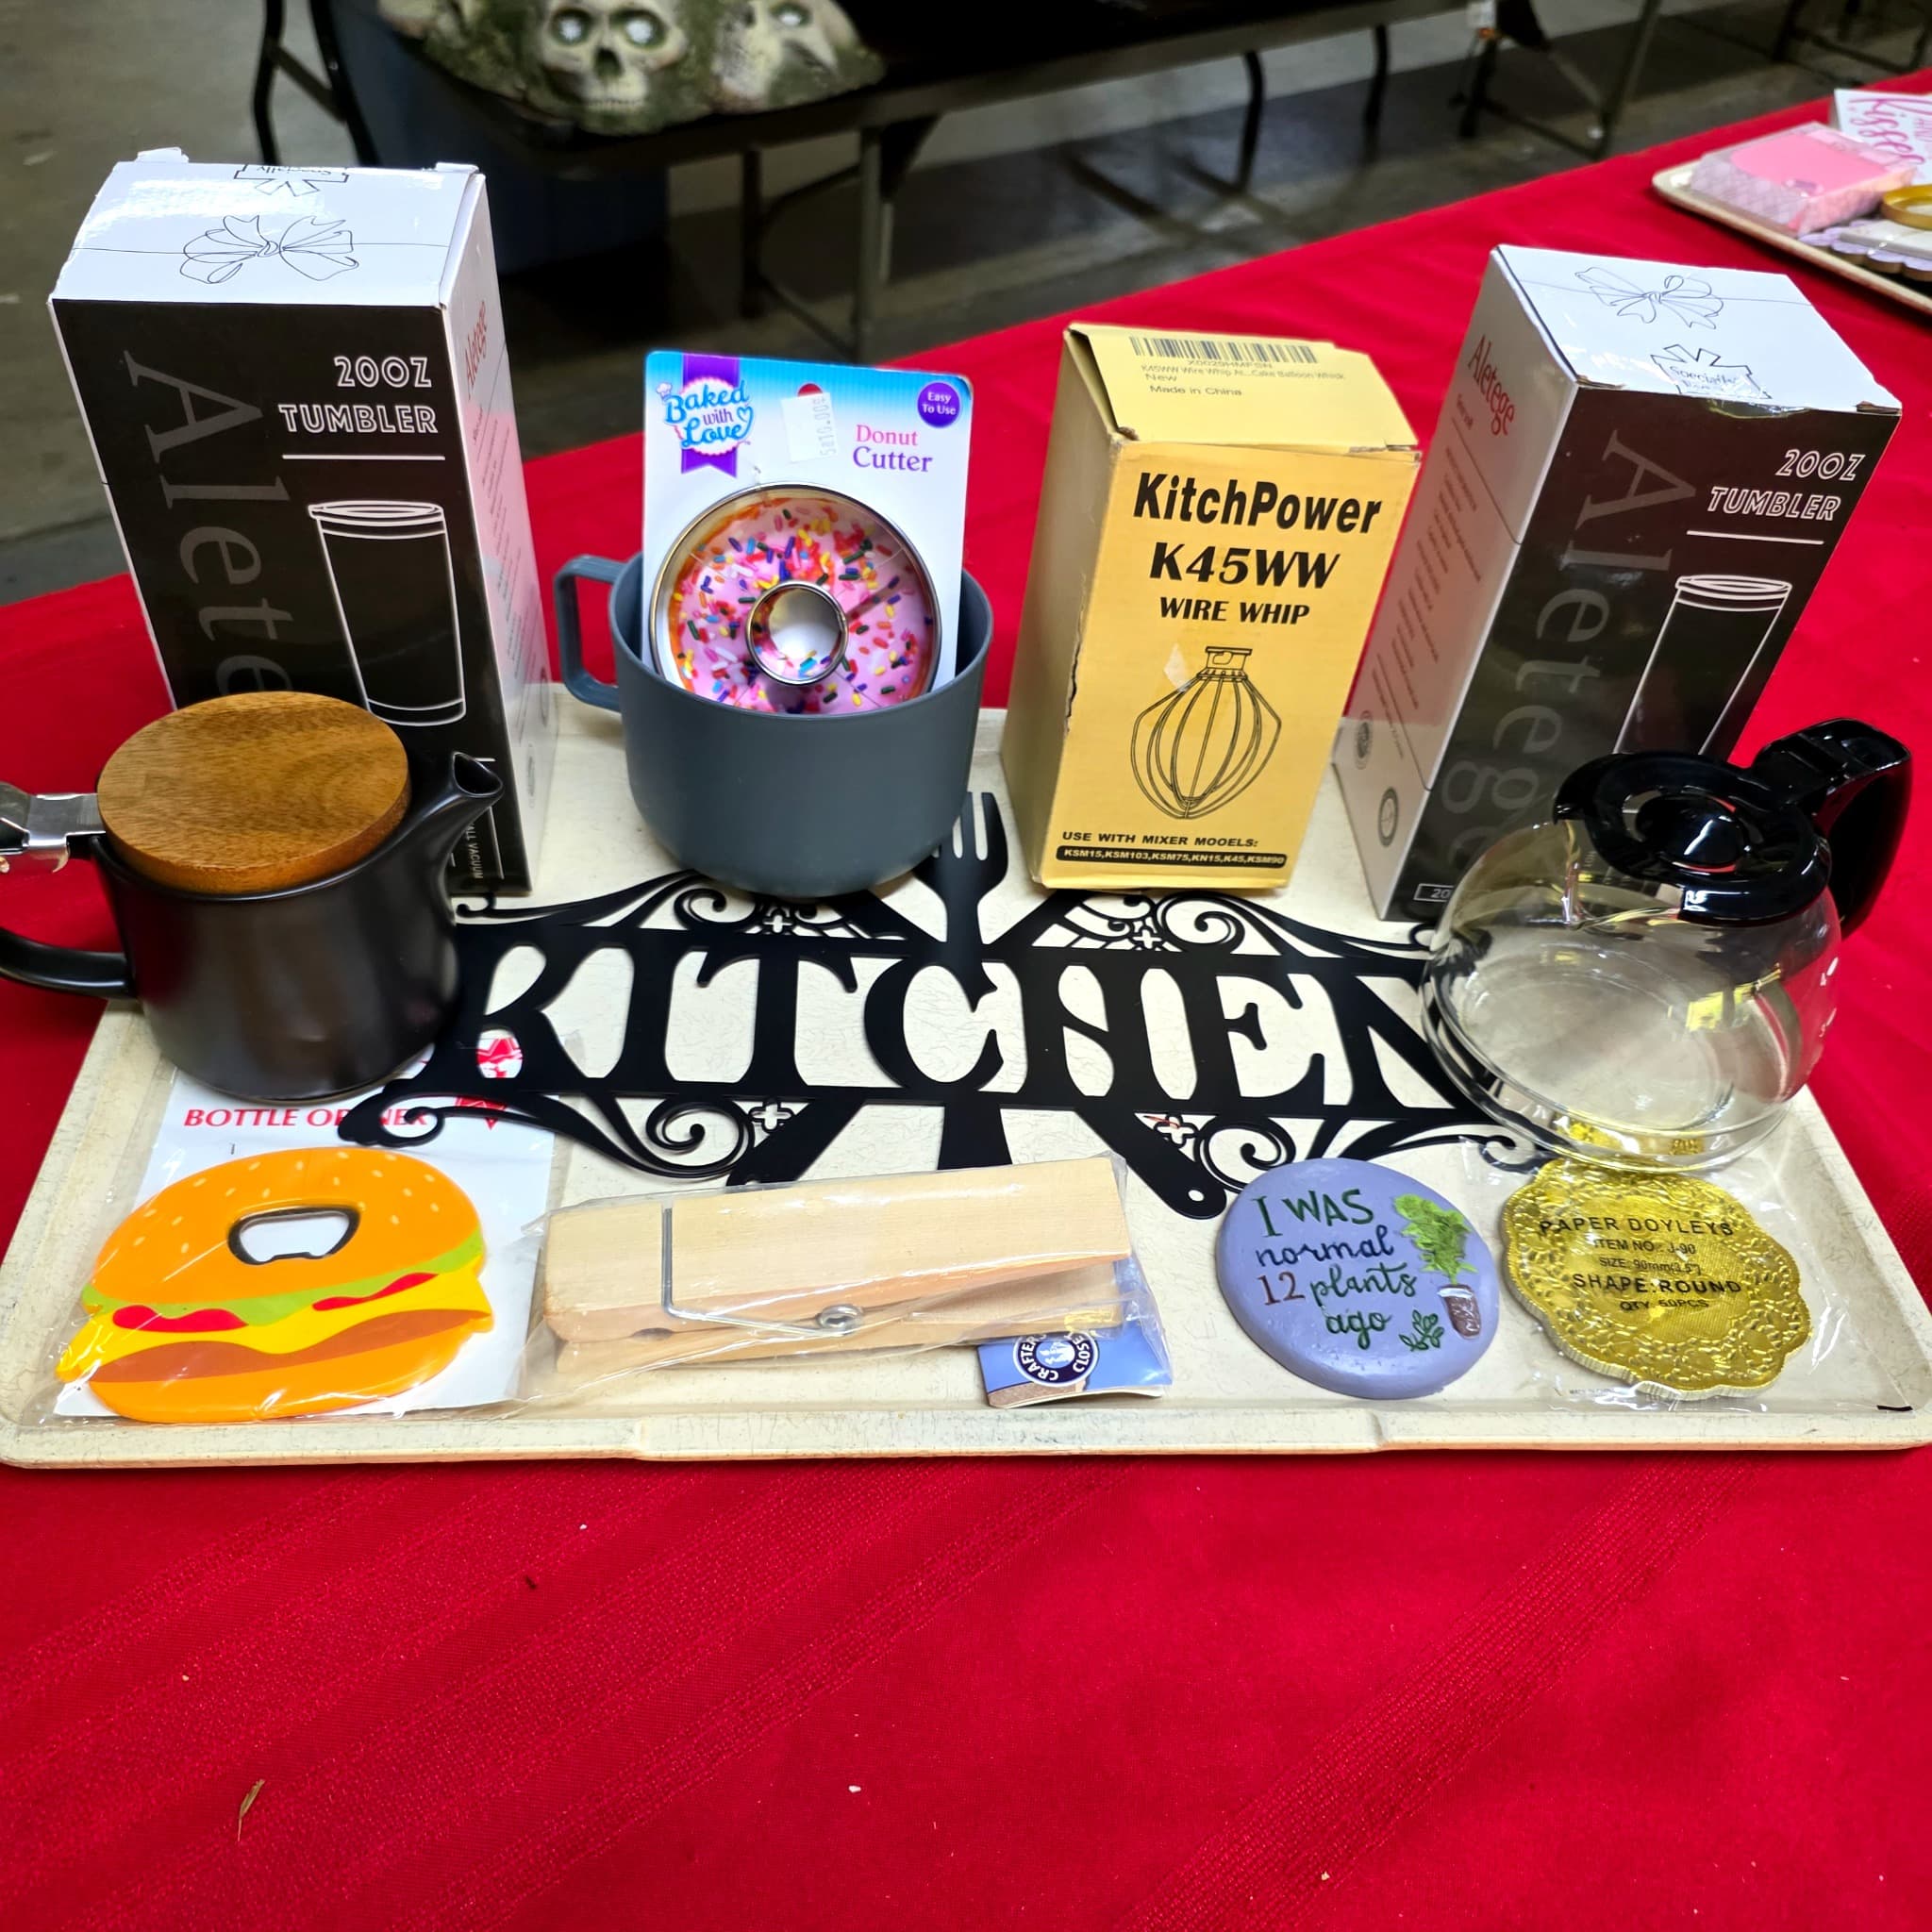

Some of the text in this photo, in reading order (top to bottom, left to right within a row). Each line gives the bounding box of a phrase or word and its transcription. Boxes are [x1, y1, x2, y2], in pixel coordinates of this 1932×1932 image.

[1145, 373, 1177, 383] New
[1149, 385, 1243, 397] Made in China
[1468, 333, 1515, 437] Aletege
[664, 379, 750, 424] Baked
[923, 403, 957, 416] To Use
[927, 391, 952, 405] Easy
[278, 404, 439, 434] TUMBLER
[703, 408, 734, 425] with
[681, 417, 741, 447] Love
[856, 425, 919, 446] Donut
[853, 446, 933, 473] Cutter
[1133, 472, 1382, 534] KitchPower
[1707, 485, 1842, 522] TUMBLER
[123, 349, 294, 694] Alete
[1149, 541, 1341, 590] K45WW
[1159, 597, 1310, 625] WIRE WHIP
[1062, 831, 1092, 842] USE
[1098, 833, 1137, 844] WITH
[1141, 835, 1189, 847] MIXER
[184, 1108, 427, 1127] BOTTLE OPNER
[1252, 1188, 1374, 1239] I WAS
[1540, 1215, 1735, 1238] PAPER DOYLEYS
[1255, 1224, 1395, 1268] normal
[1594, 1239, 1629, 1251] ITEM
[1257, 1262, 1419, 1307] 12 plants
[1324, 1309, 1392, 1351] ago
